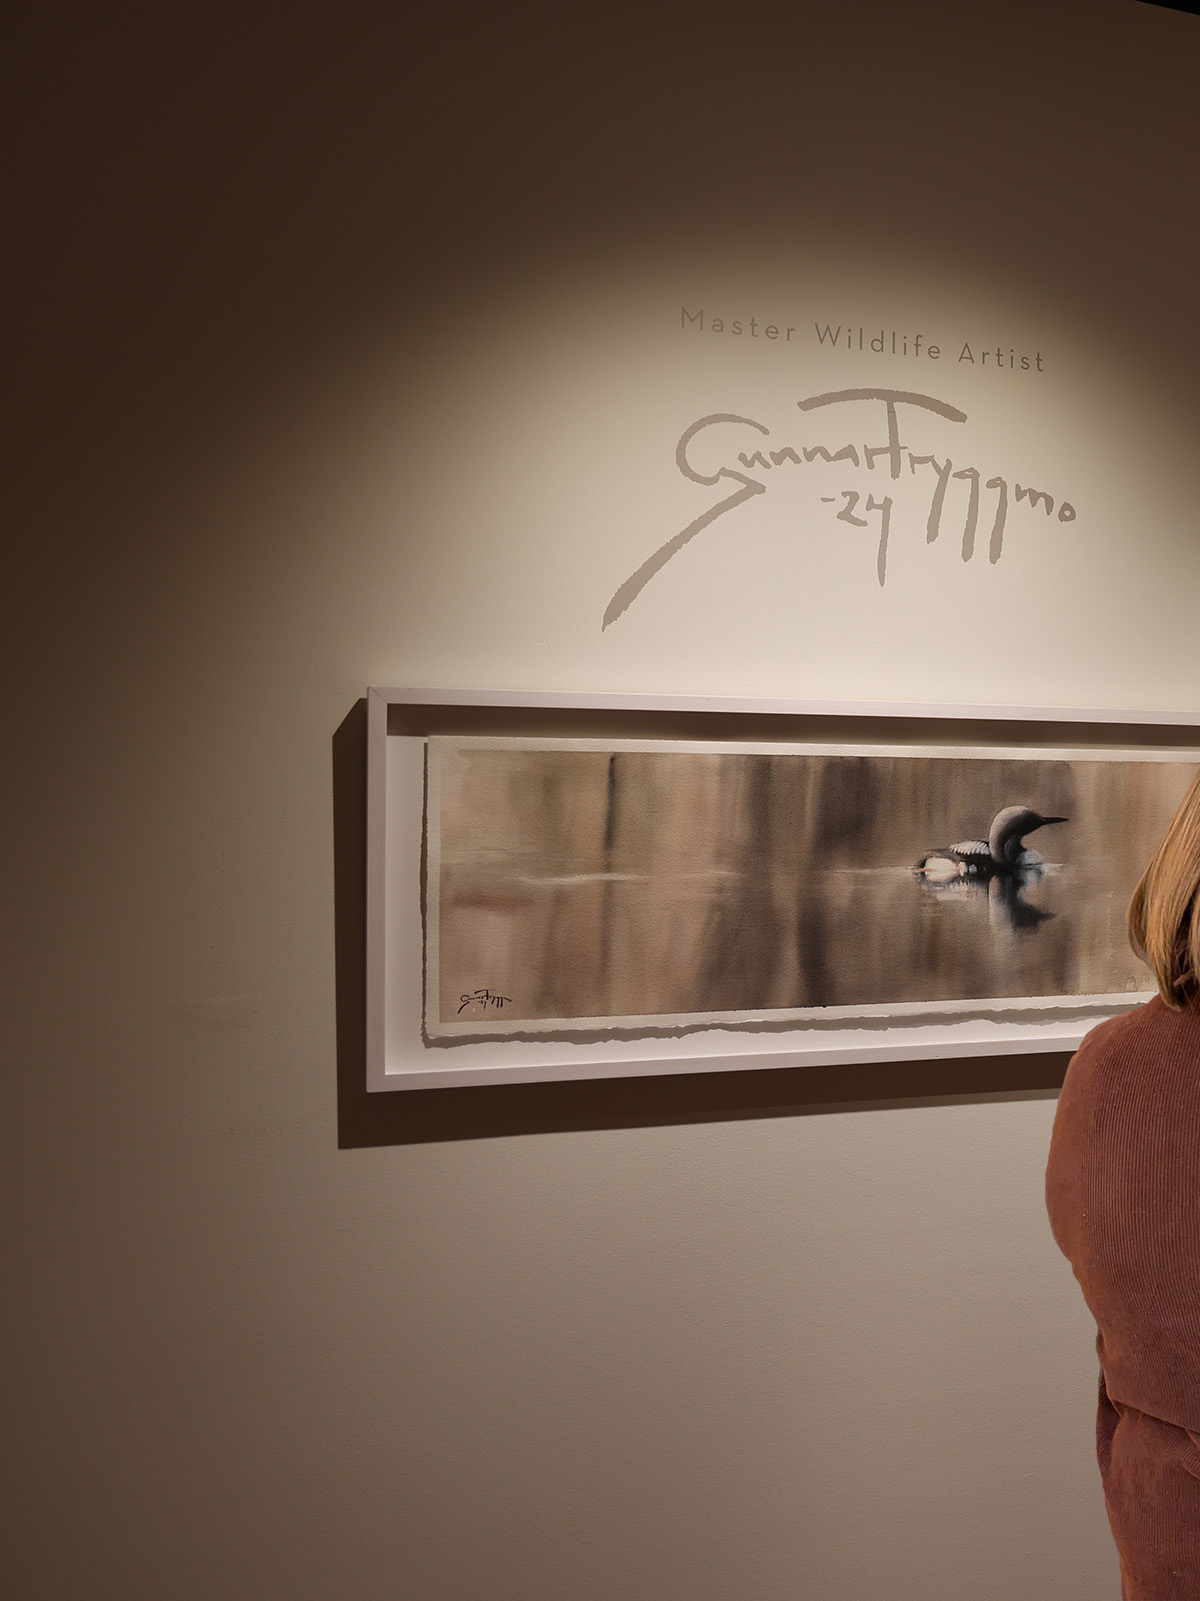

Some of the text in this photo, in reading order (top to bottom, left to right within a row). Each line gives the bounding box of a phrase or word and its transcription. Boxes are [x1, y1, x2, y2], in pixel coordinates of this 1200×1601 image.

[680, 306, 1045, 373] Master Wildlife Artist
